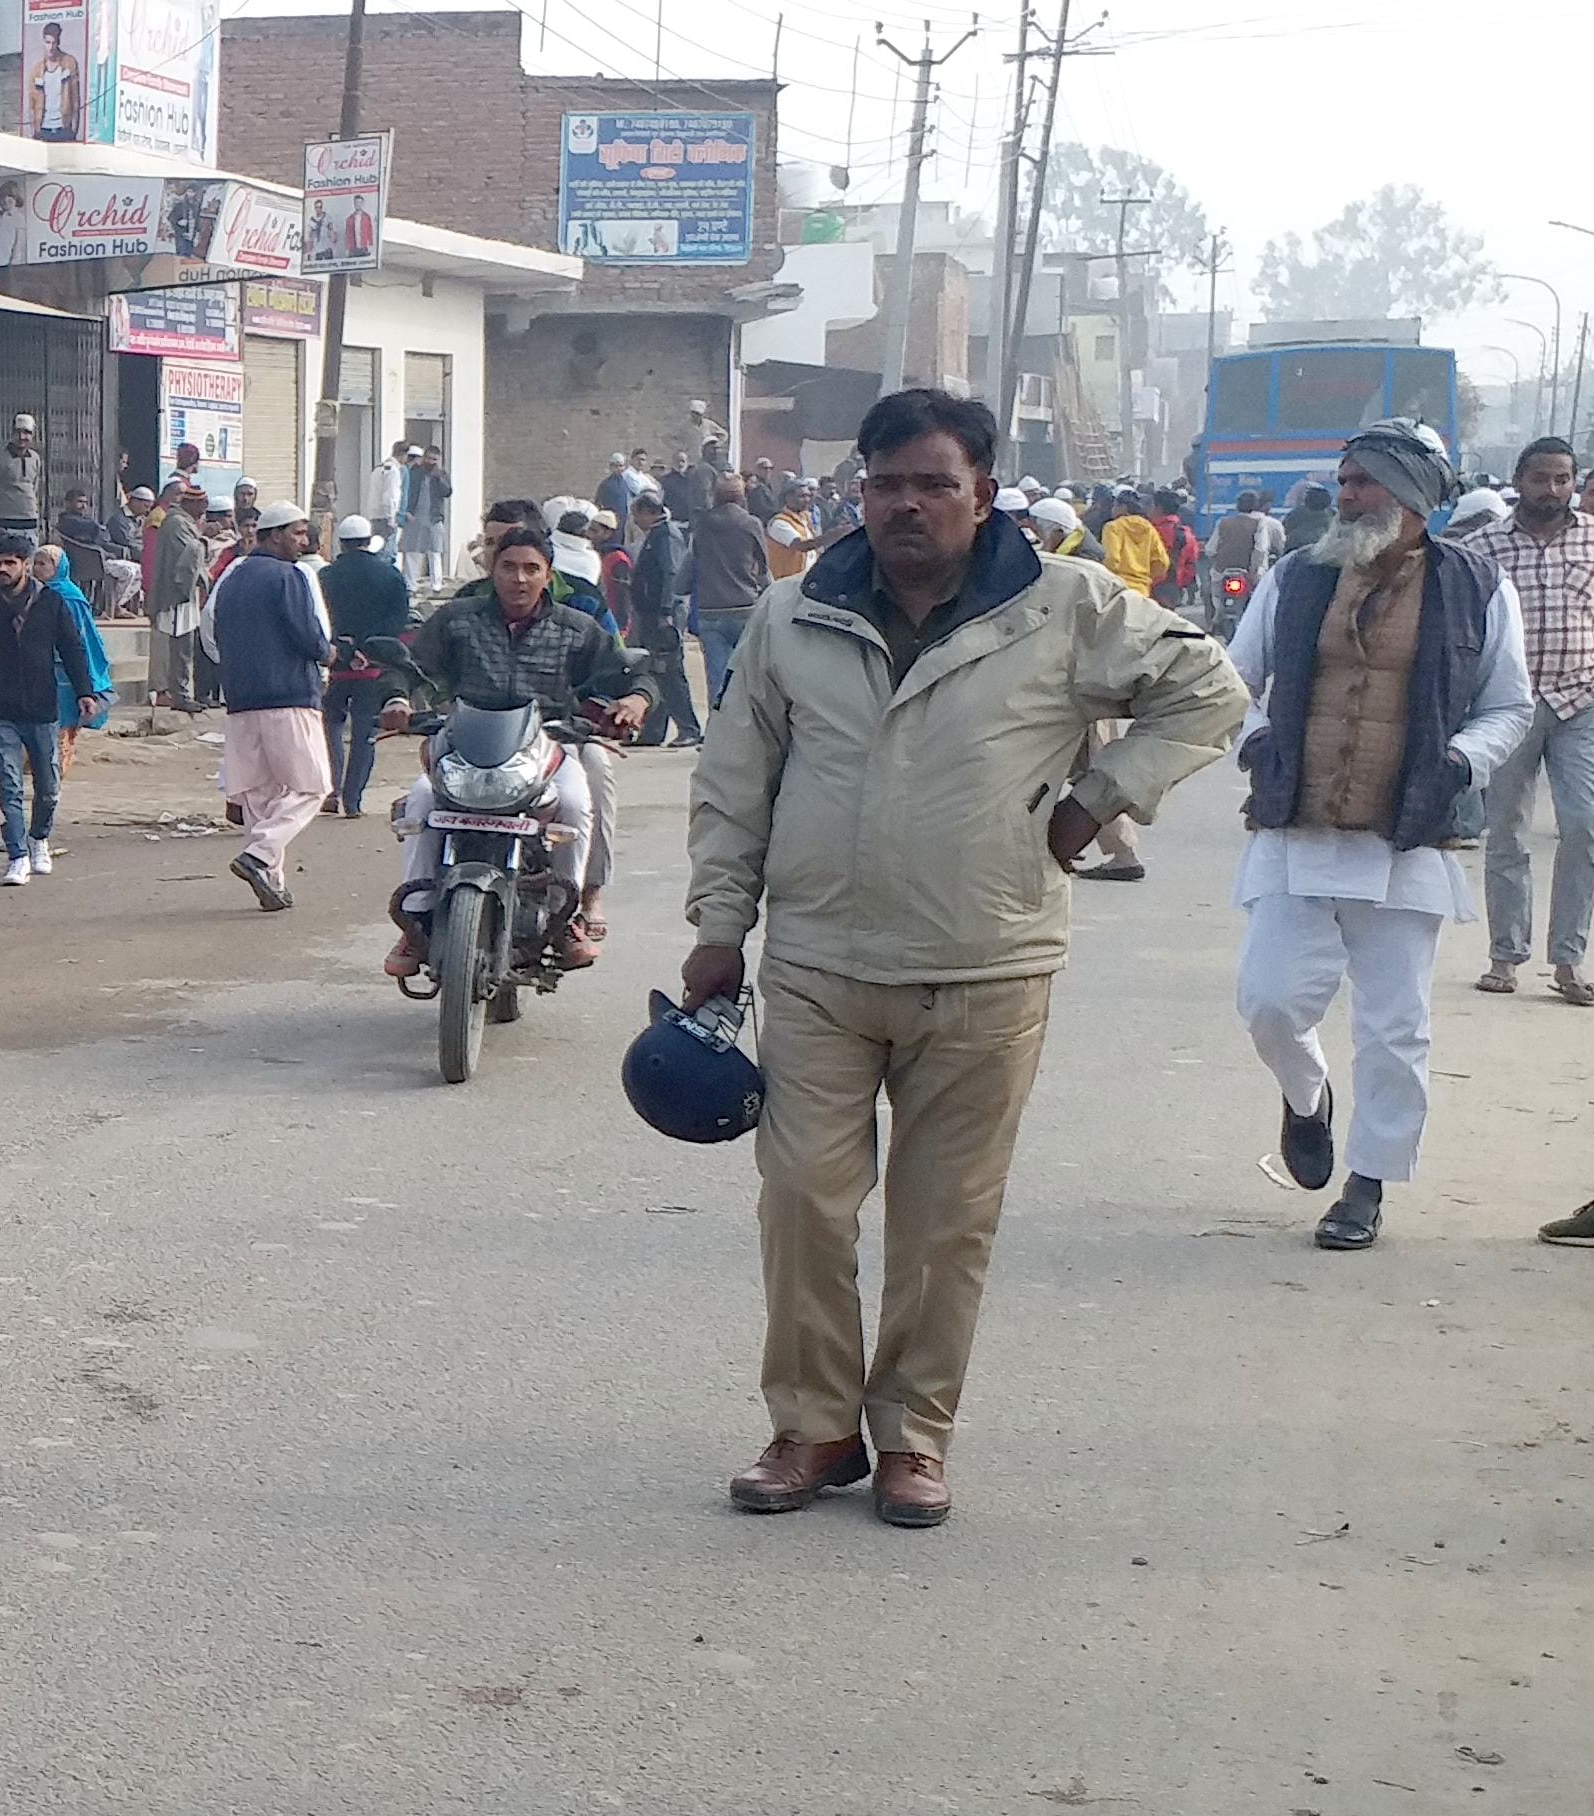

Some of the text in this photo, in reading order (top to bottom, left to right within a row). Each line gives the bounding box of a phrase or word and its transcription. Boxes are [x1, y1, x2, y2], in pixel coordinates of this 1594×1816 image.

[118, 89, 189, 135] Fashion Hub
[307, 145, 378, 179] Orchid
[307, 173, 377, 189] Fashion Hub
[33, 182, 152, 240] Orchid
[224, 186, 286, 260] Orchid
[39, 238, 148, 258] Fashion Hub
[169, 369, 242, 401] PHYSIOTHERAPY
